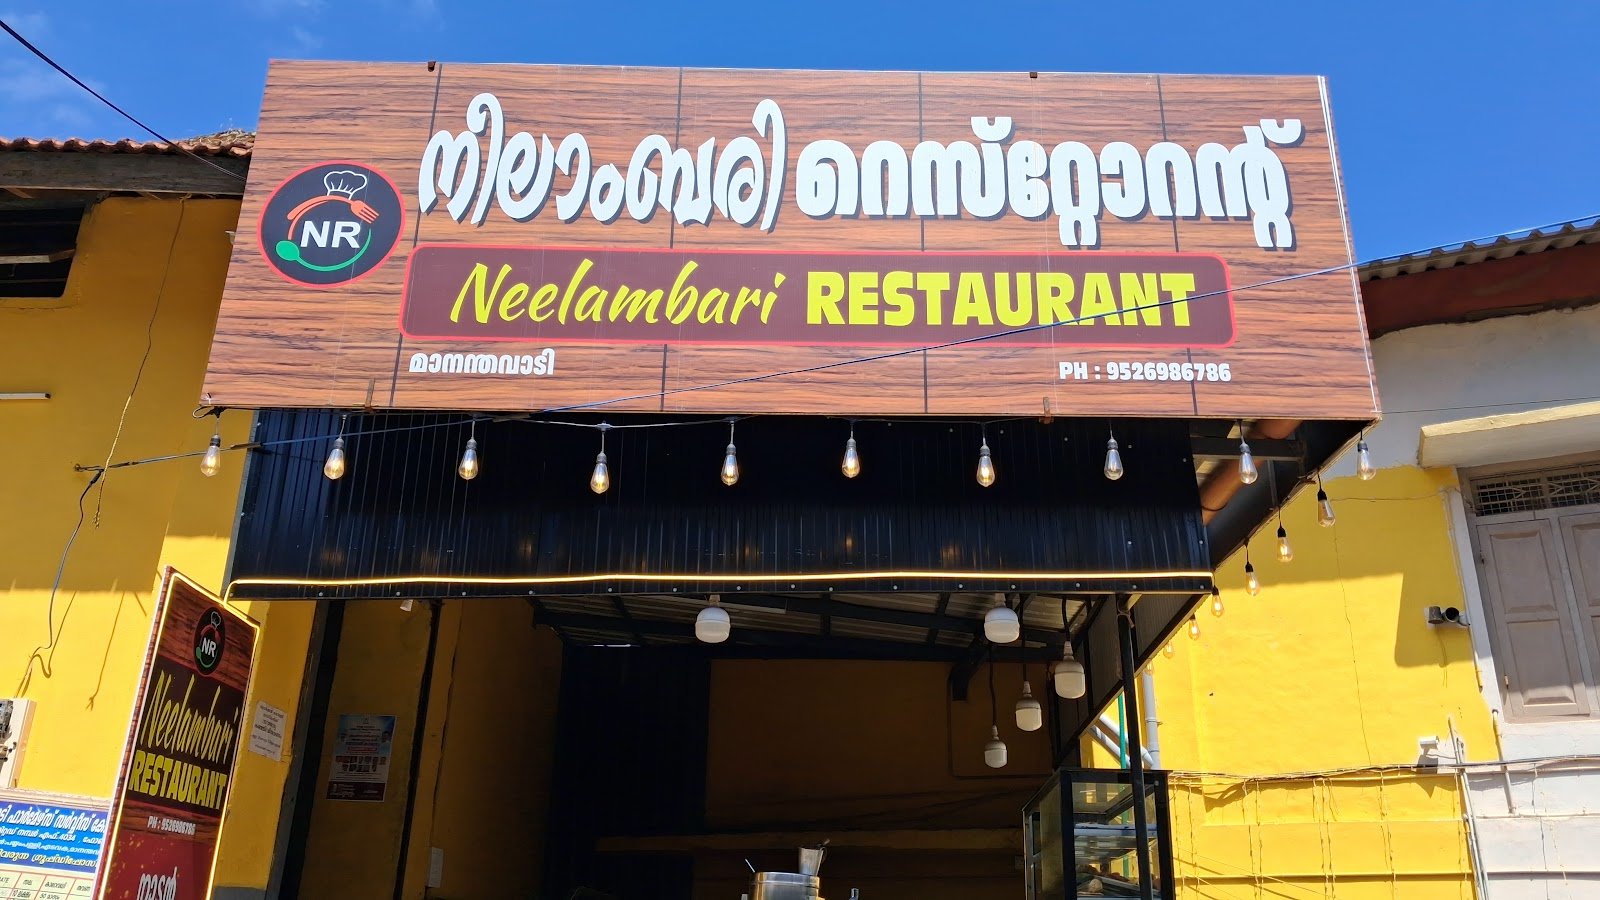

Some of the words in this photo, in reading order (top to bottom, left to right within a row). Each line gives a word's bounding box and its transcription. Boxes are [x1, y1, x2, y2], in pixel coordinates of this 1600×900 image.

[417, 92, 785, 230] നീലാംബരി
[299, 220, 361, 250] NR
[449, 258, 786, 326] Neelambari
[806, 270, 1196, 327] RESTAURANT
[408, 348, 556, 376] മാനന്തവാടി
[1058, 361, 1089, 380] PH
[1106, 361, 1232, 382] 9526986786
[201, 638, 217, 658] NR
[140, 669, 239, 765] Neelambari
[128, 750, 228, 810] RESTAURANT
[147, 815, 158, 829] PH
